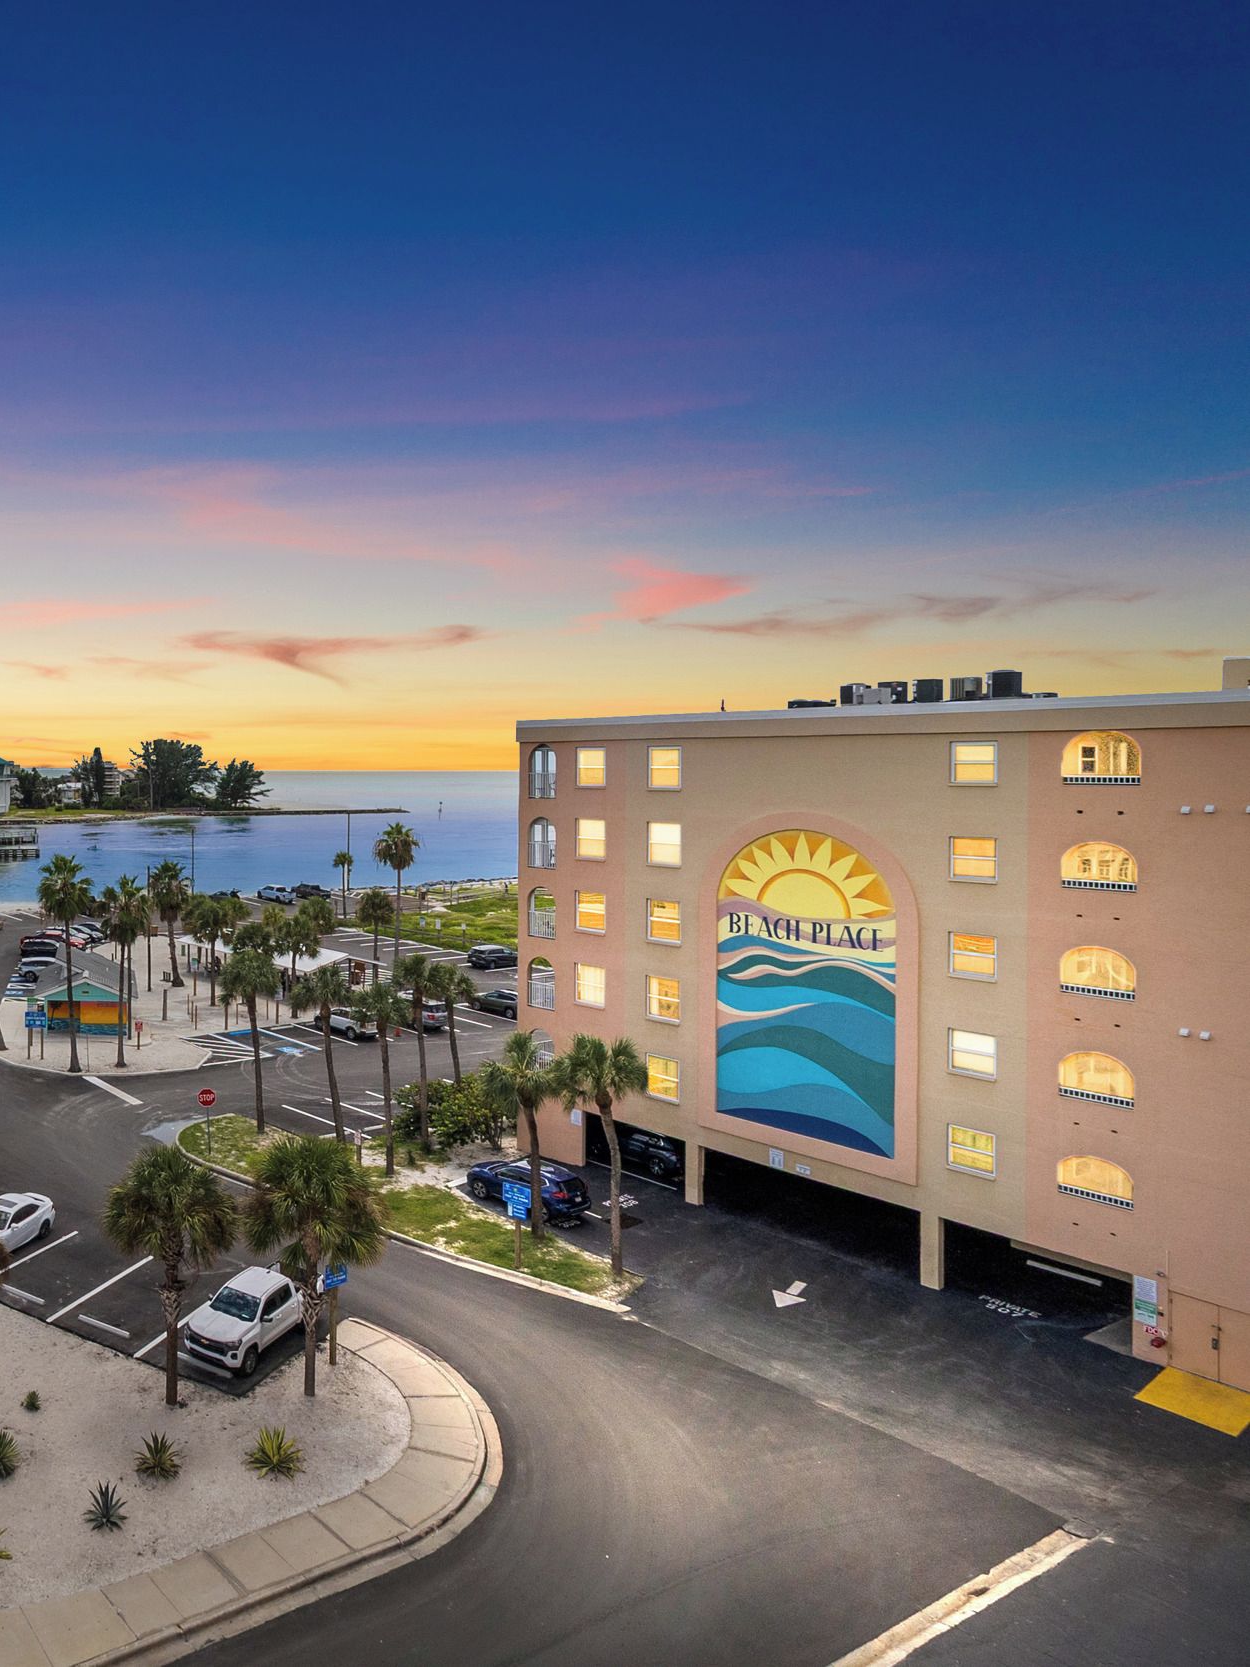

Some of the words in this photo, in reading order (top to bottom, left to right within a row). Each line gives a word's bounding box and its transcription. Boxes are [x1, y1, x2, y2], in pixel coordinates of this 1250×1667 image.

[729, 912, 801, 942] BEACH
[811, 921, 884, 953] PLACE
[199, 1093, 215, 1102] STOP
[978, 1295, 1042, 1319] PRIVATE
